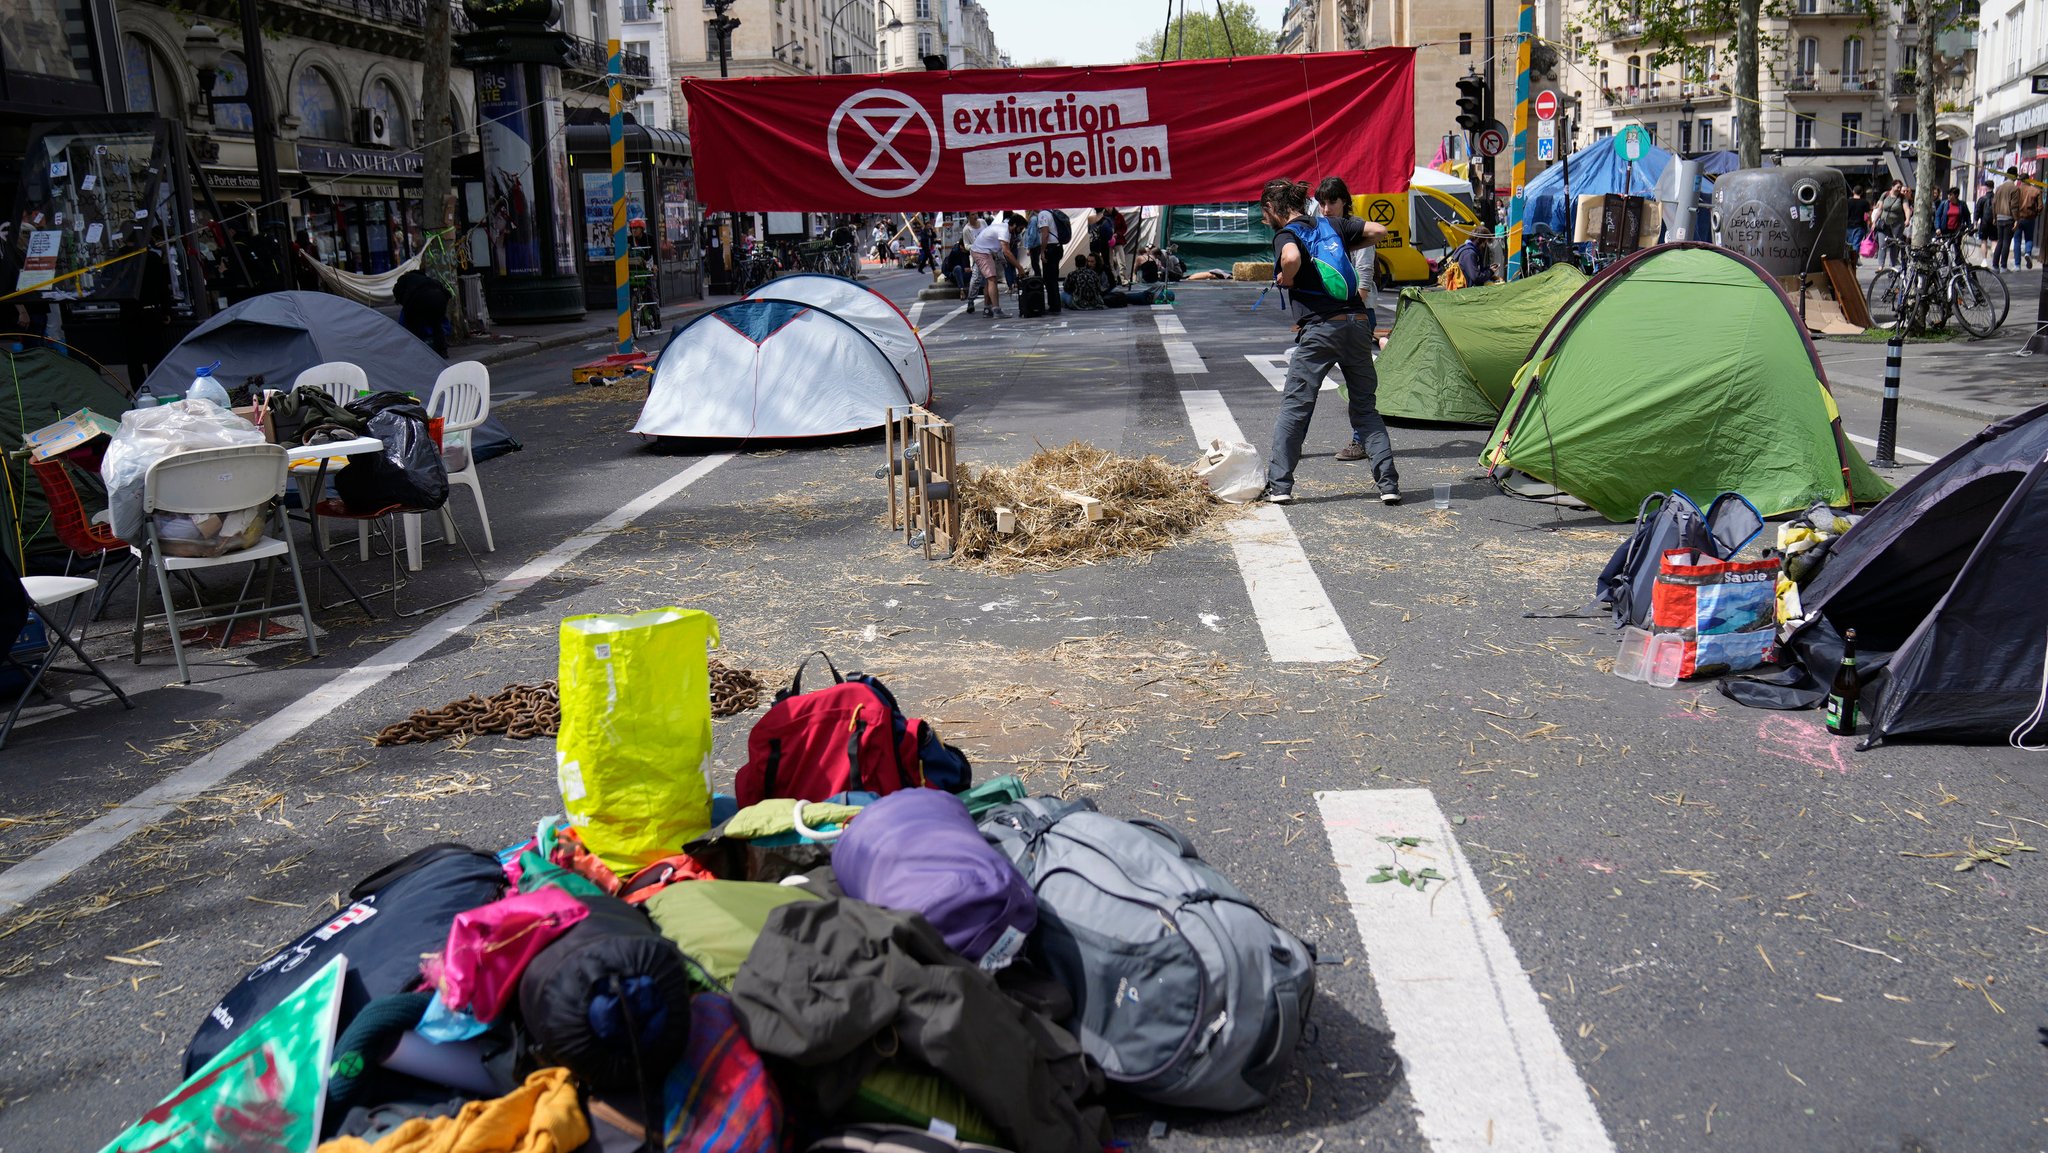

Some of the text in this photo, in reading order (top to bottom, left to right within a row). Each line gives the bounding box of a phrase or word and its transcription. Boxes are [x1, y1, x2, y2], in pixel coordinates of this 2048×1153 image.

[953, 93, 1122, 135] extinction
[325, 151, 347, 169] LA
[352, 153, 389, 171] NUIT
[1009, 132, 1162, 178] rebellion
[214, 174, 237, 186] Porter
[361, 185, 372, 195] LA
[377, 186, 394, 196] NUIT
[1741, 206, 1755, 217] LA
[1730, 216, 1781, 229] DÉMOCRATIE
[1727, 229, 1791, 242] N'EST PAS
[1750, 247, 1764, 258] UN
[1769, 246, 1810, 259] ISOLOIR
[1724, 570, 1768, 584] Savoie
